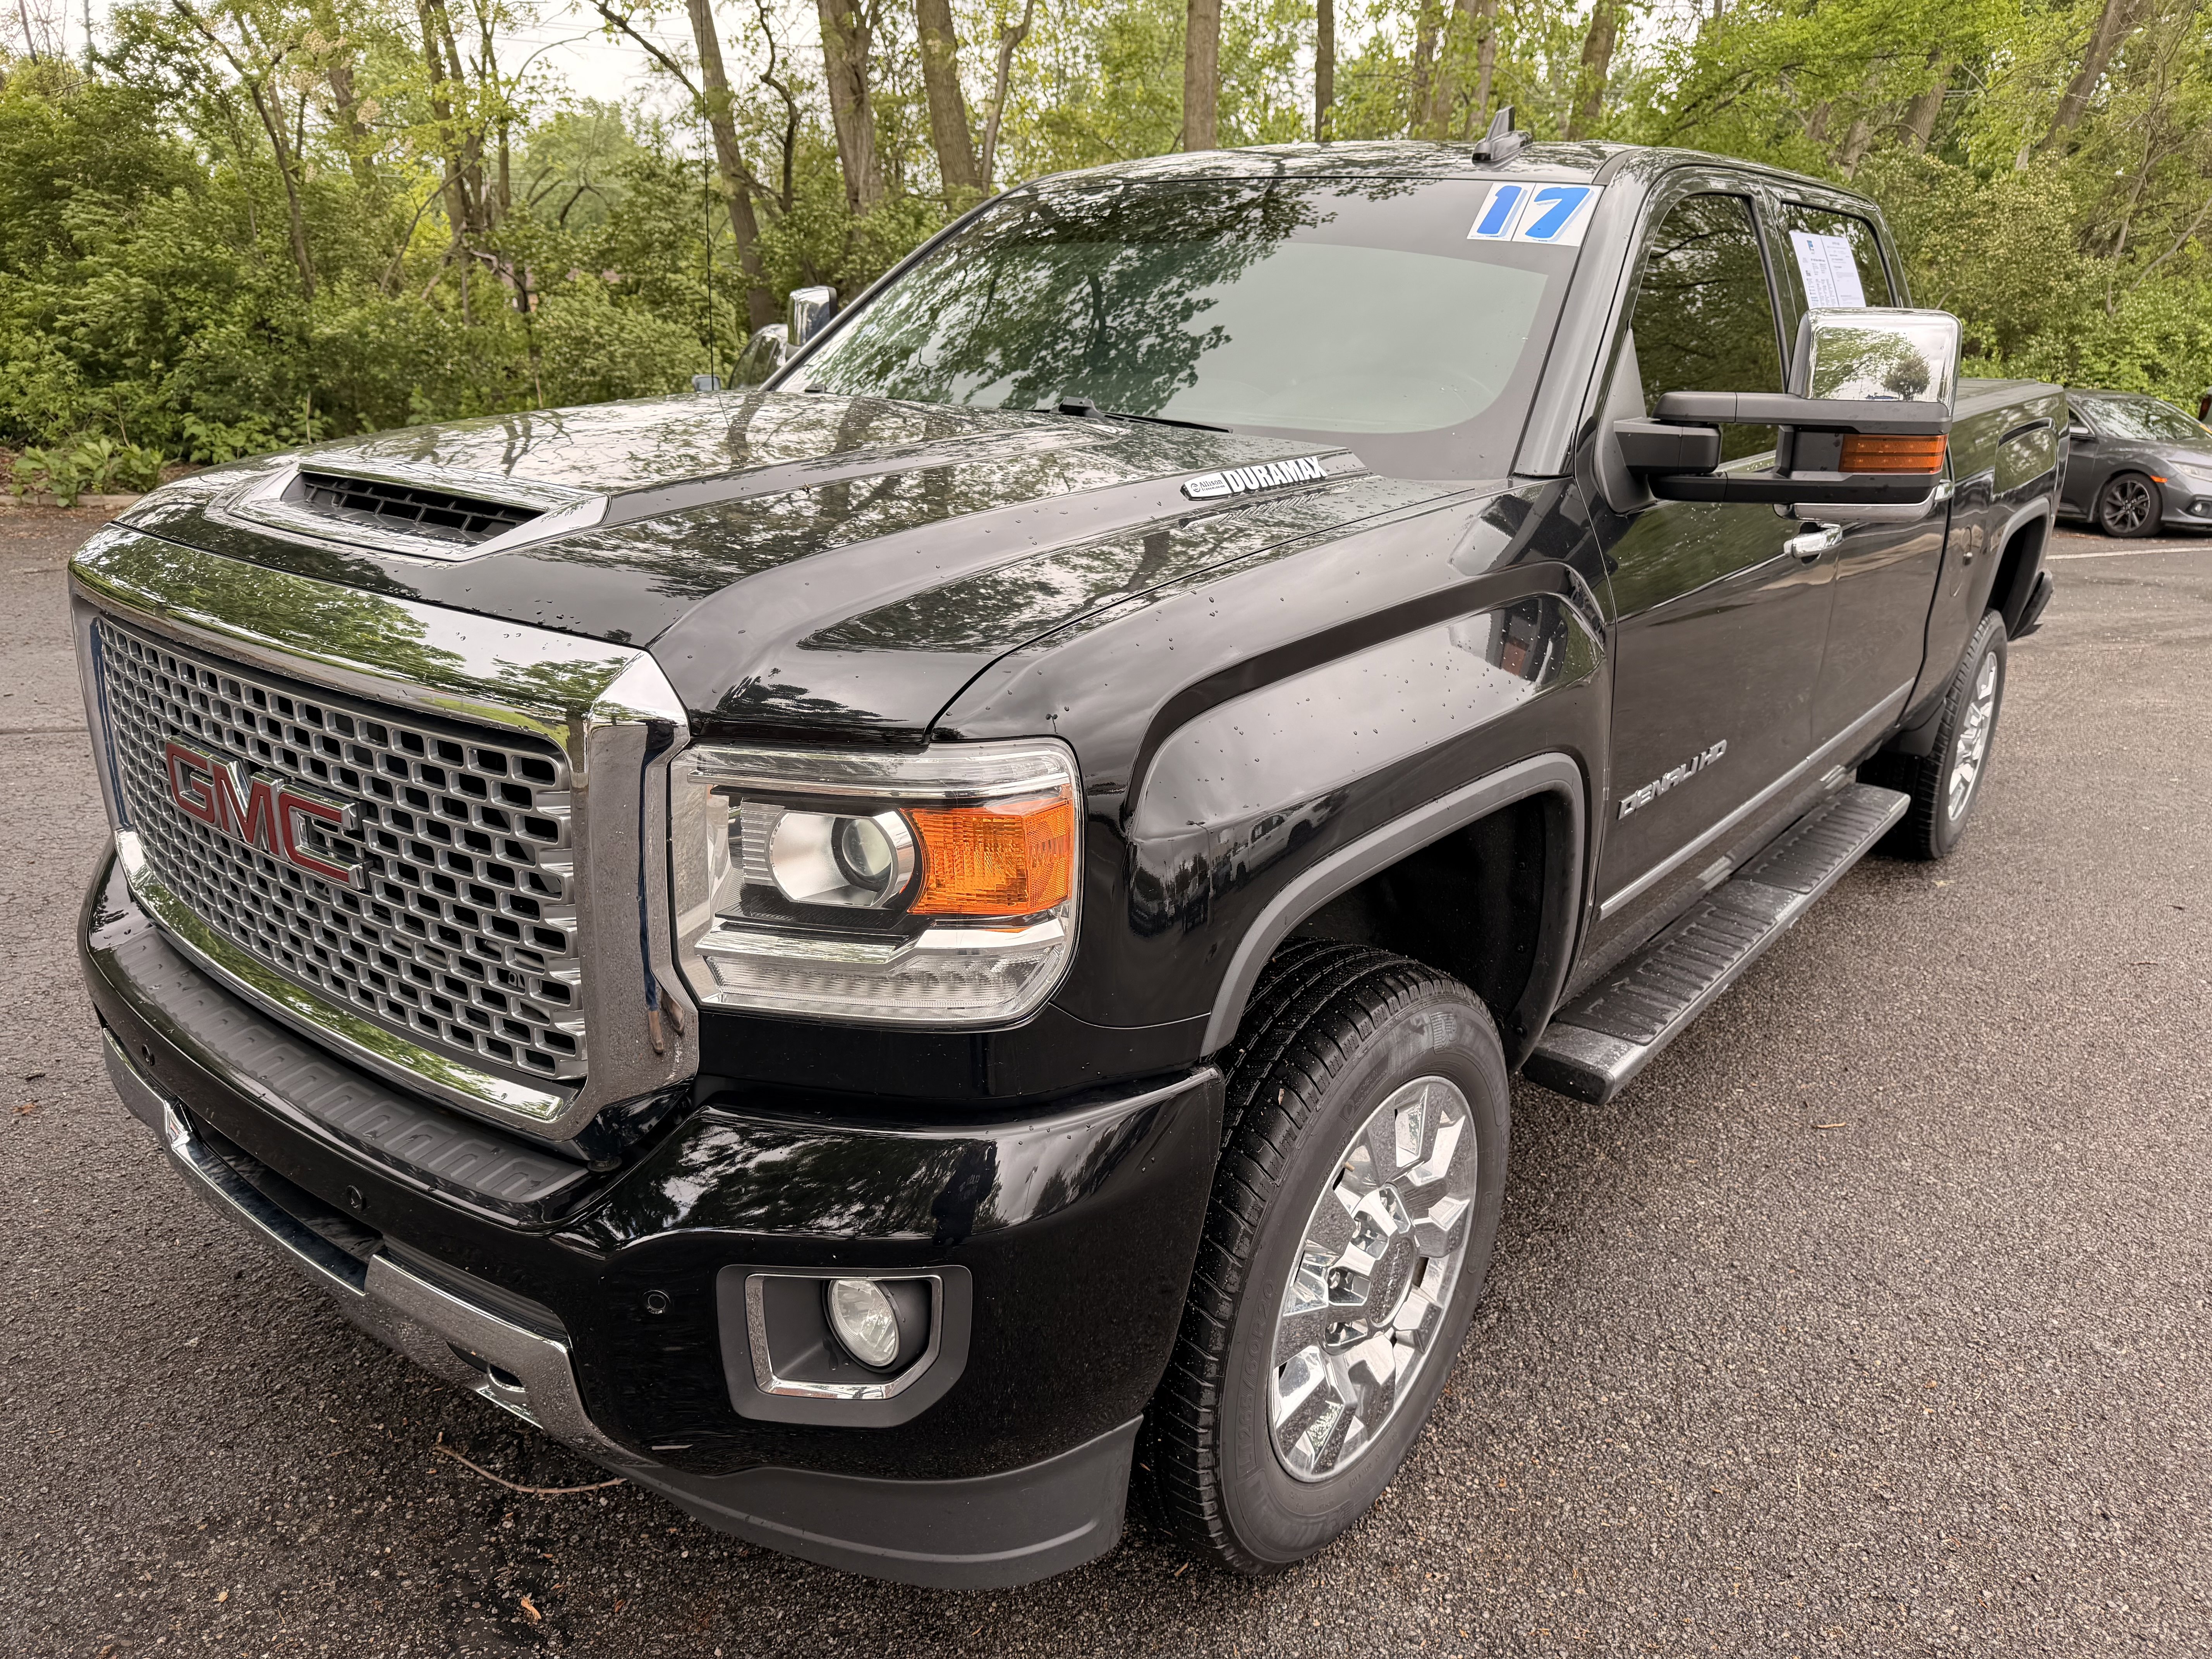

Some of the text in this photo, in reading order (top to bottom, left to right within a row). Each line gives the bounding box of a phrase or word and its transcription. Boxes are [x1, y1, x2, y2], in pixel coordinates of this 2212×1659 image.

[1476, 185, 1592, 239] 17
[1199, 480, 1223, 488] Allison
[1223, 456, 1328, 493] DURAMAX
[1617, 739, 1727, 821] DENALI HD
[165, 735, 366, 890] GMC
